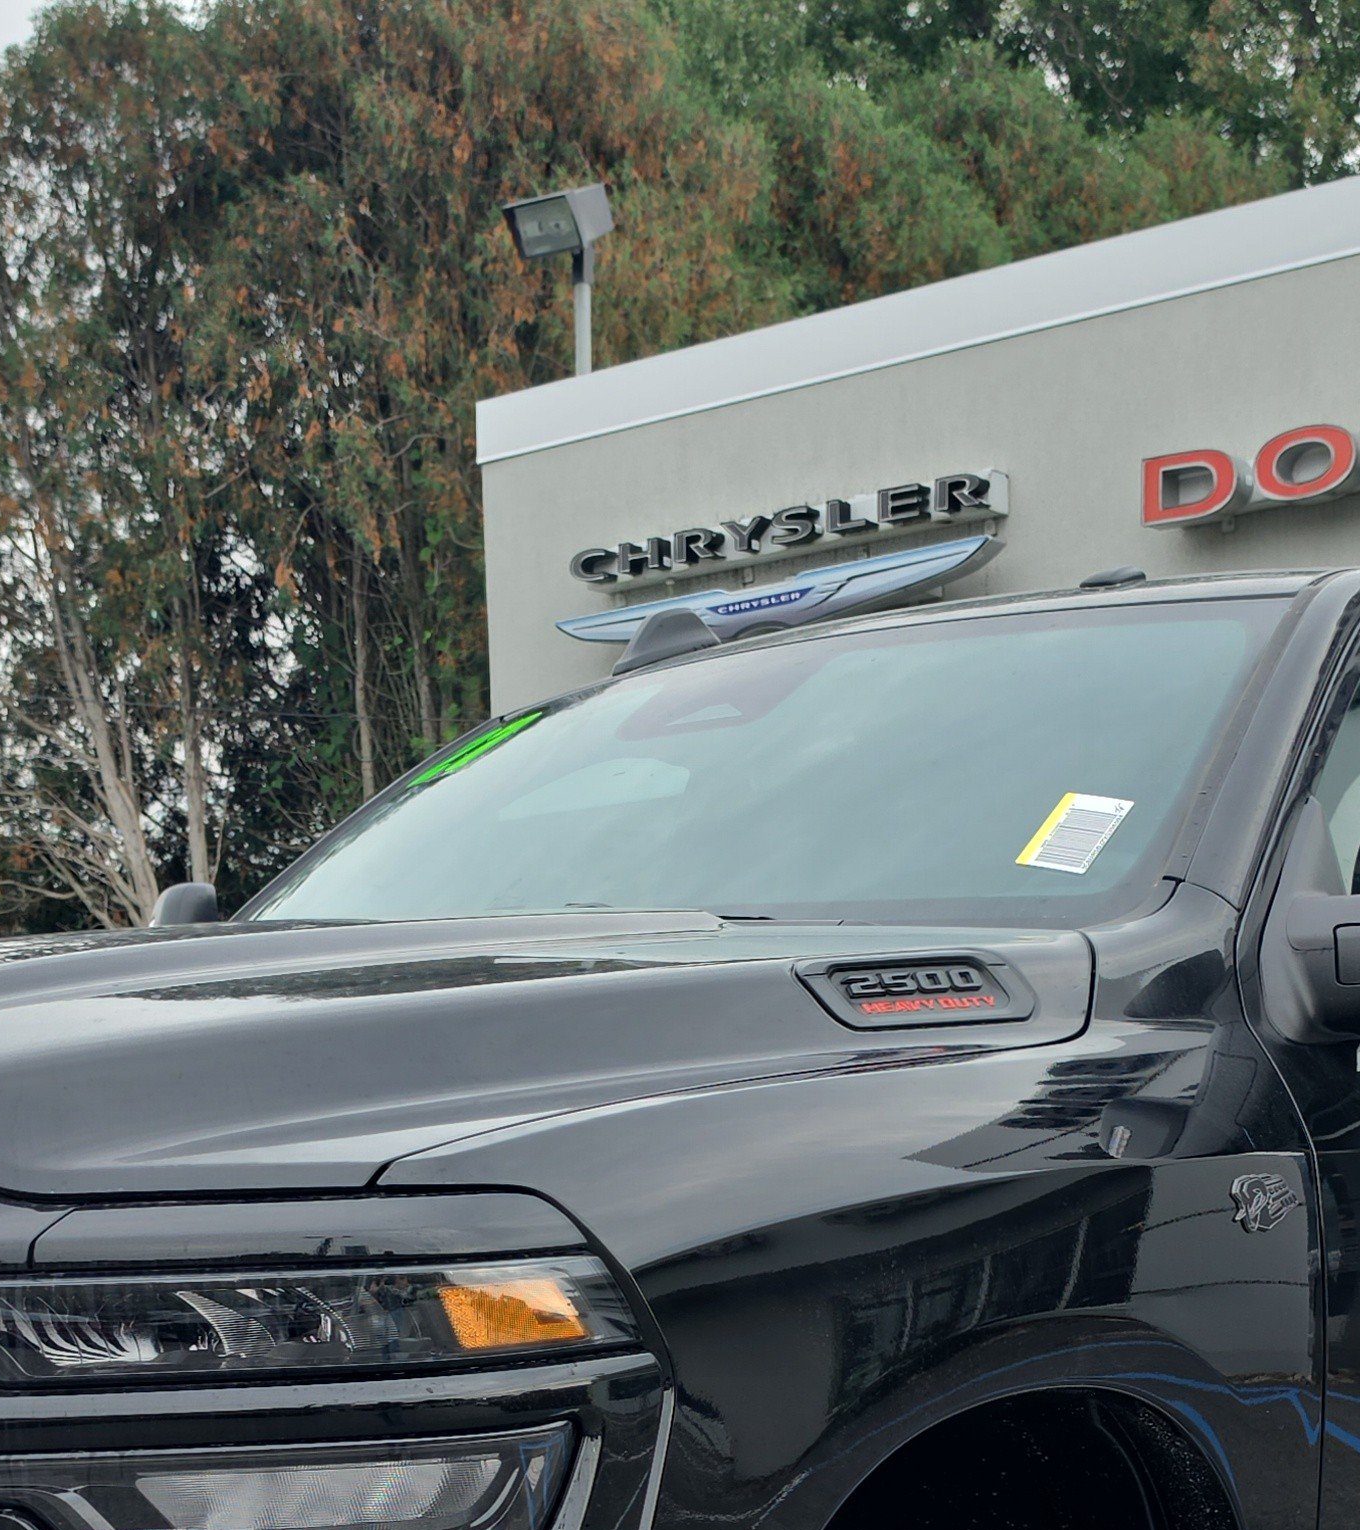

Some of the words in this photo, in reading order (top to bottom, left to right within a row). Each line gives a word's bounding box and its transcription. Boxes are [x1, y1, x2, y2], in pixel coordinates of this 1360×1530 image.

[569, 473, 990, 583] CHRYSLER
[717, 592, 800, 615] CHRYSLER
[841, 969, 983, 998] 2500
[861, 999, 934, 1015] HEAVY
[938, 996, 996, 1010] DUTY
